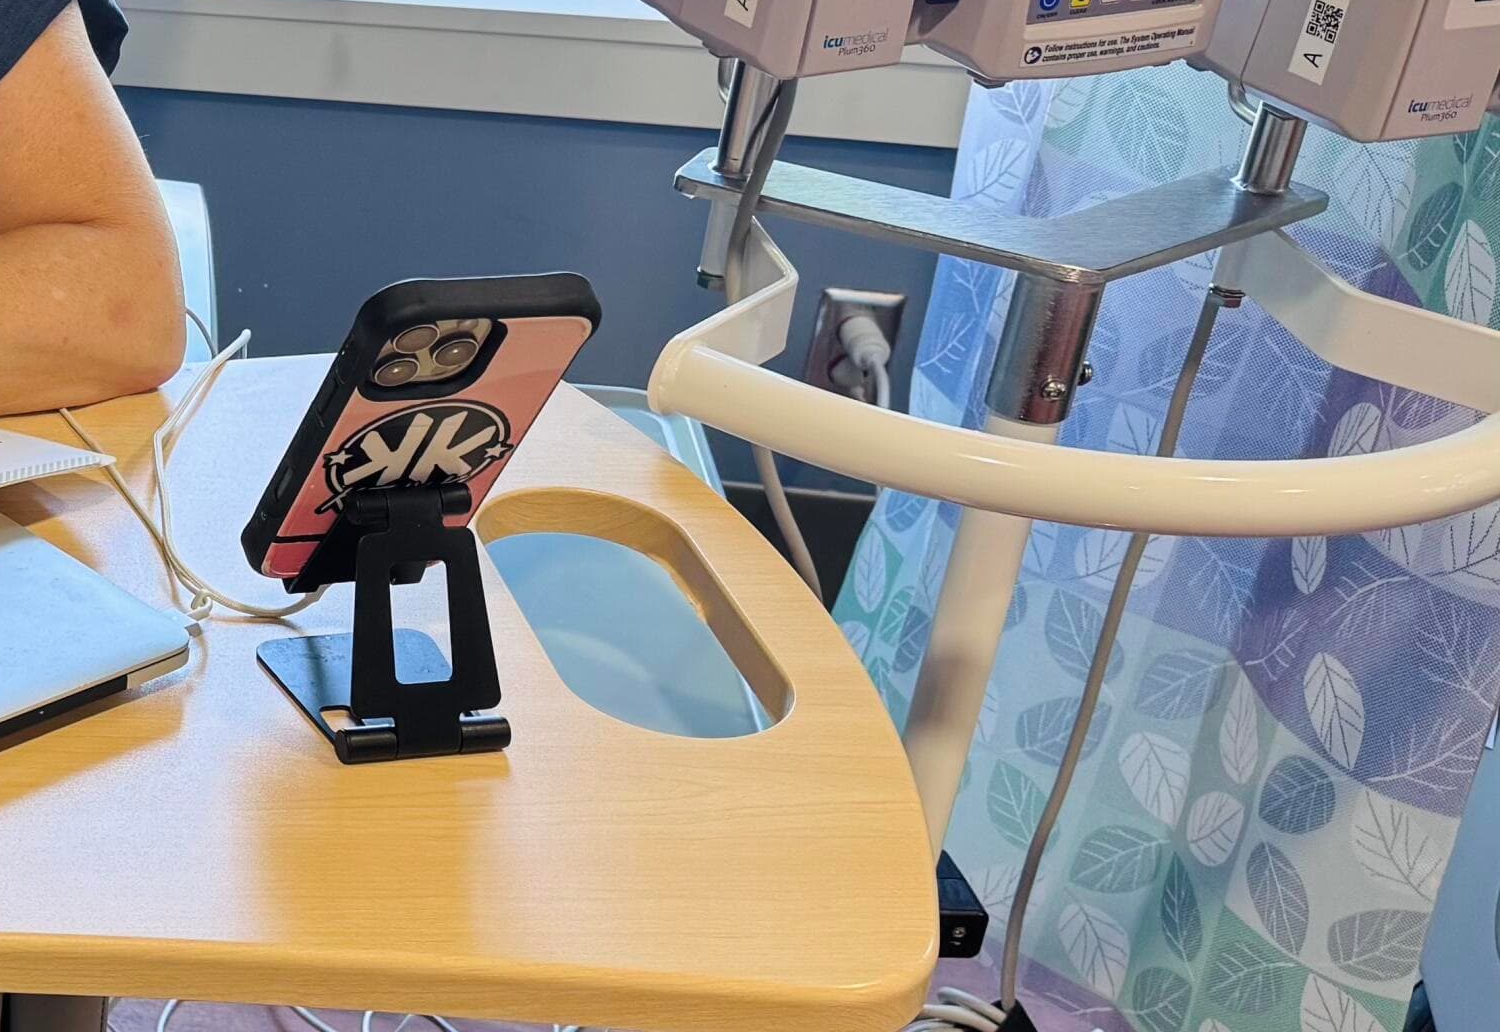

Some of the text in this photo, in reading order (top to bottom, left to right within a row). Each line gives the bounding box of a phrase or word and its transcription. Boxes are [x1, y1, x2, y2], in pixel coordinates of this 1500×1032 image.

[823, 28, 889, 49] icumedical
[1044, 44, 1064, 53] Follow
[1064, 41, 1098, 51] instructions
[1098, 40, 1107, 48] for
[1120, 36, 1130, 45] The
[1042, 54, 1067, 63] contains
[1067, 51, 1087, 61] proper
[1125, 44, 1137, 53] and
[1303, 52, 1323, 68] A
[1408, 92, 1474, 114] icumedical
